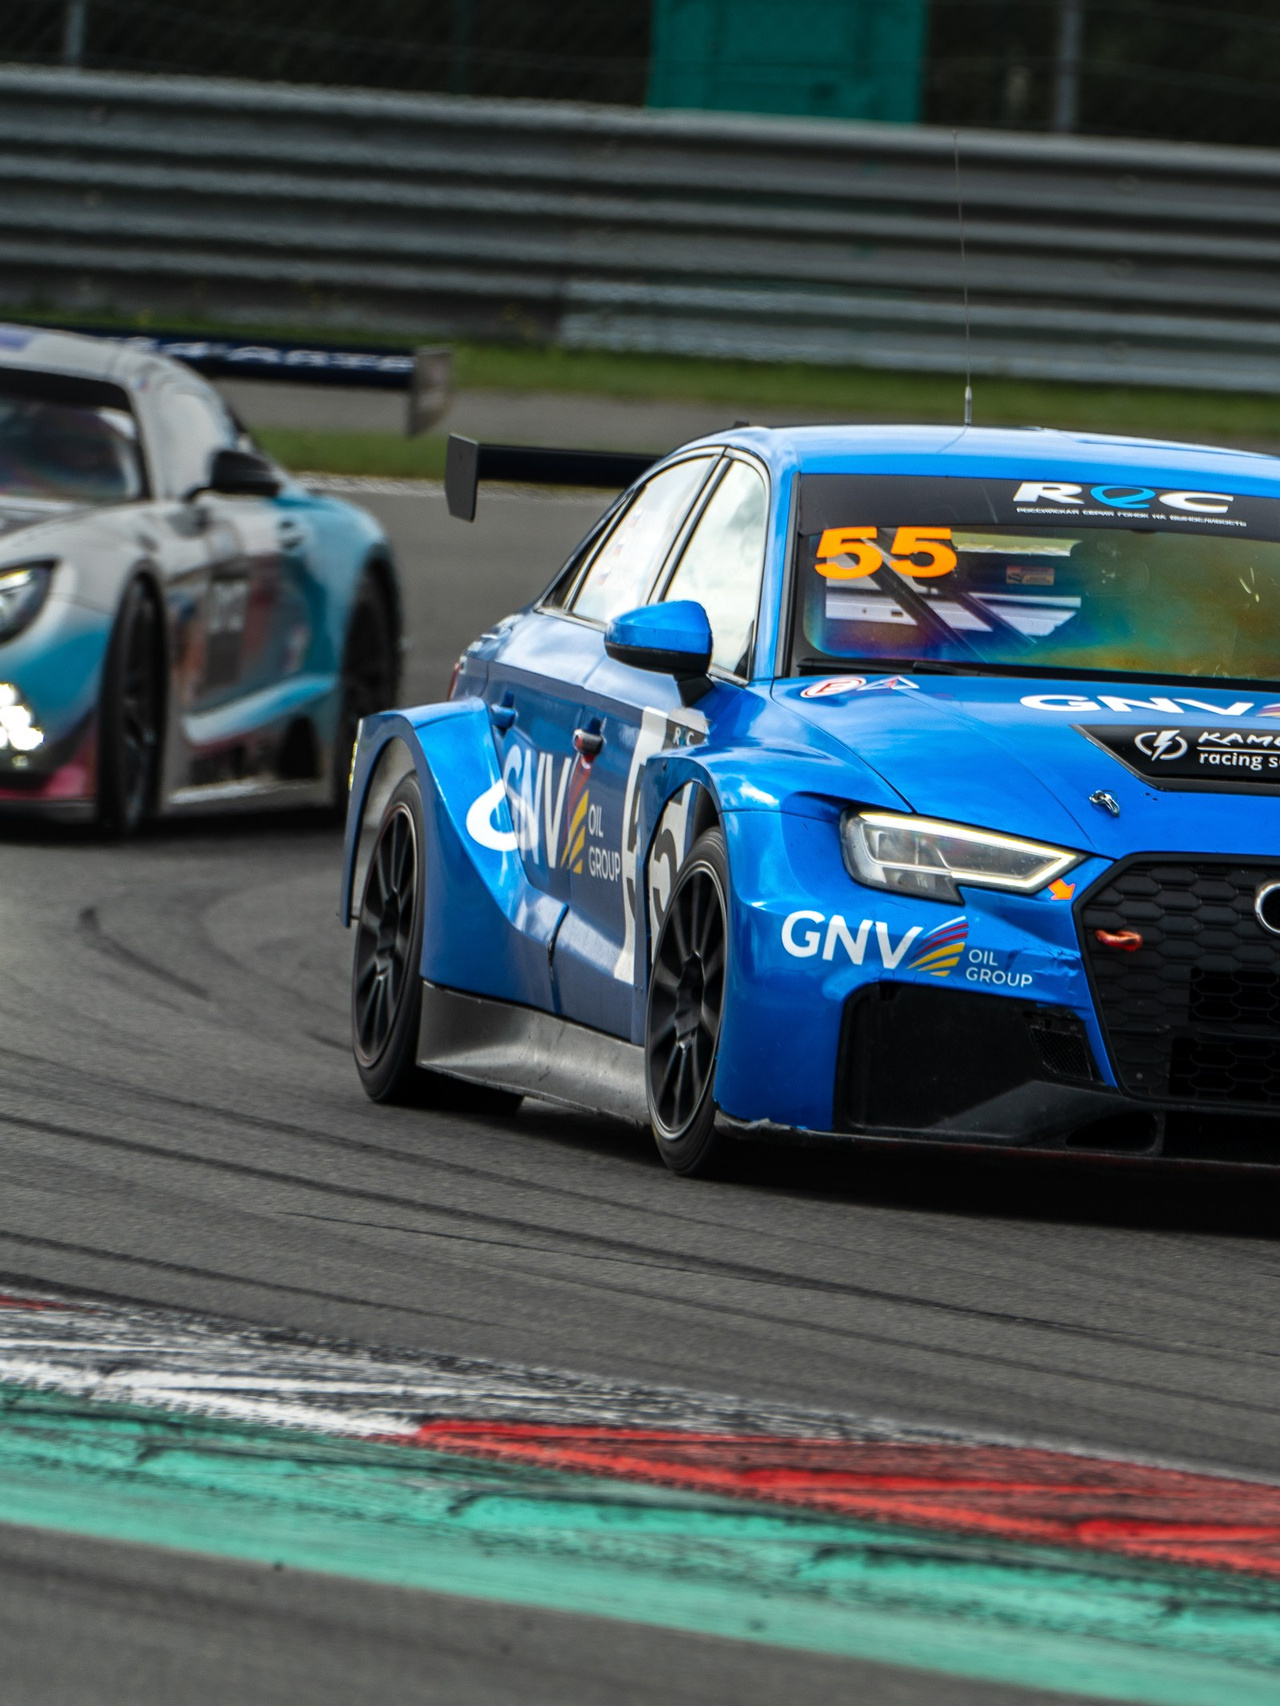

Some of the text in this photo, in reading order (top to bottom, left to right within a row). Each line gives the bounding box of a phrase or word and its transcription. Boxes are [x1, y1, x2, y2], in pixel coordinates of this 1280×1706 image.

[814, 526, 958, 580] 55
[1019, 694, 1255, 716] GNV
[1199, 752, 1263, 771] racing
[466, 745, 572, 869] GNV
[587, 803, 605, 838] OIL
[588, 846, 621, 883] GROUP
[781, 910, 924, 970] GNV
[968, 949, 998, 966] OIL
[965, 967, 1033, 988] GROUP
